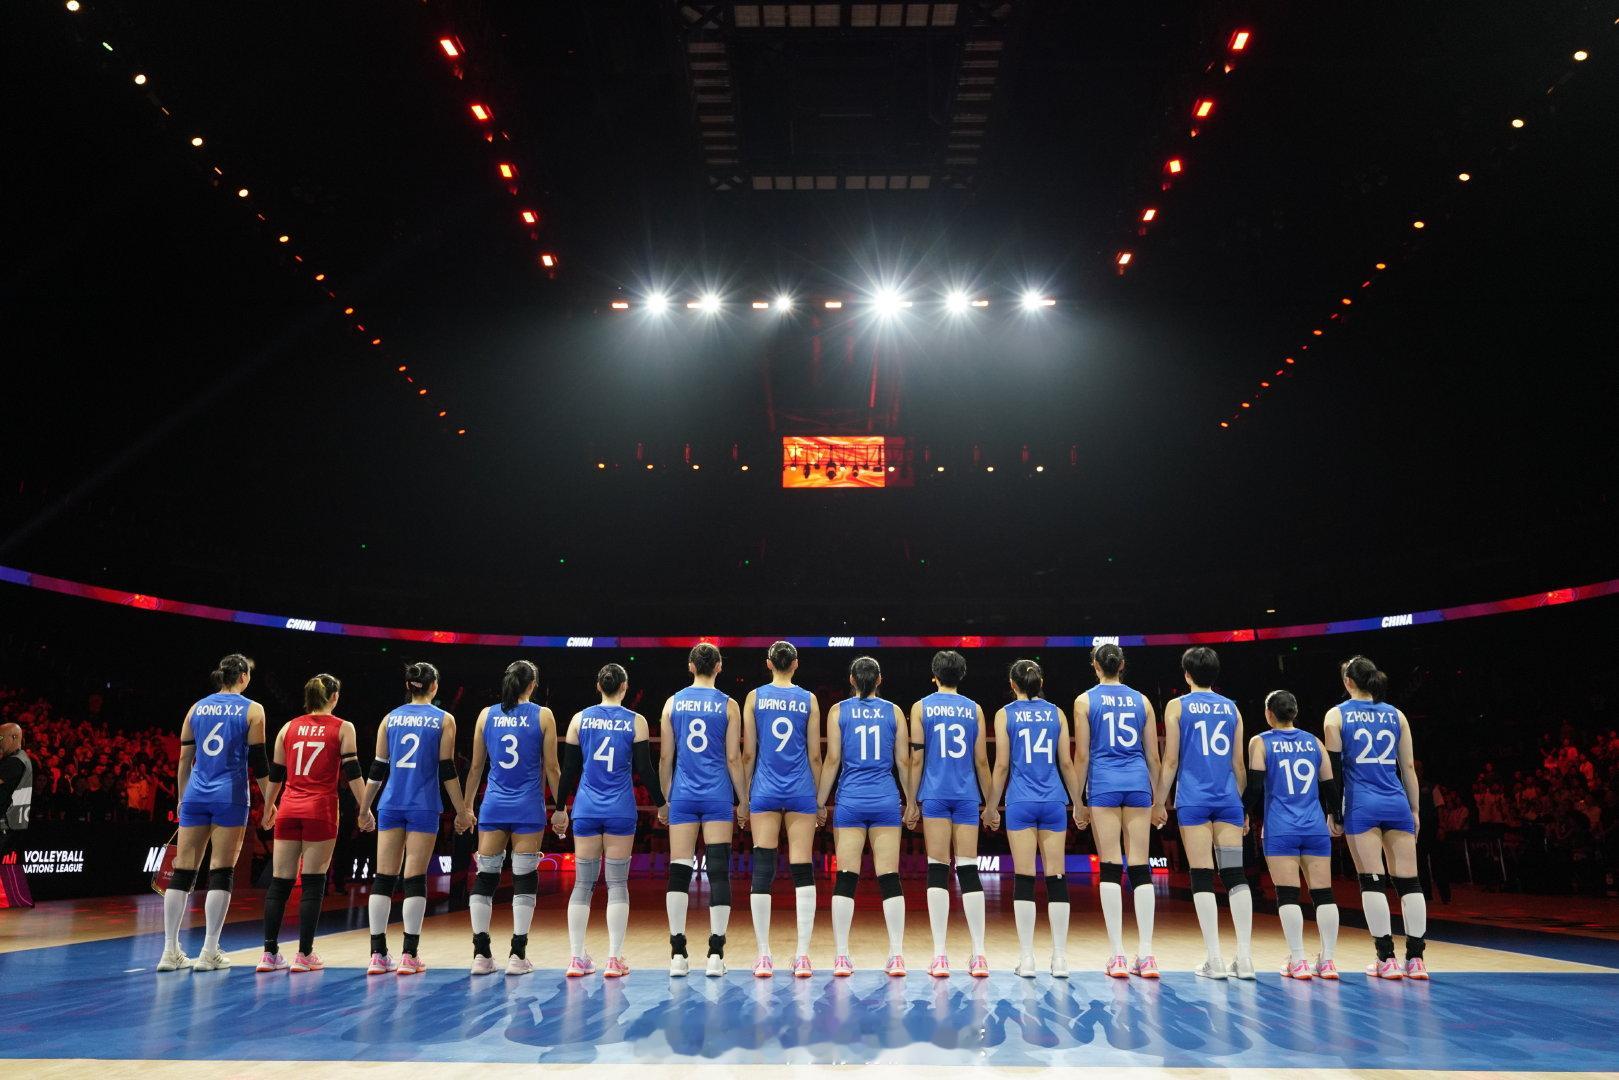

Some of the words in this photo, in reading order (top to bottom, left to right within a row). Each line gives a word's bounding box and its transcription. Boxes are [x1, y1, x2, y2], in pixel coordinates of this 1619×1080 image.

[286, 618, 317, 631] CHINA
[1382, 614, 1412, 627] CHINA
[567, 636, 594, 648] CHINA
[828, 636, 855, 648] CHINA
[675, 700, 702, 712] CHEN
[758, 698, 787, 711] WANG
[1100, 694, 1115, 706] JIN
[1117, 695, 1137, 707] J.B.
[196, 704, 222, 717] GONG
[223, 704, 244, 717] X.Y.
[851, 708, 861, 719] LI
[862, 708, 885, 719] C.X.
[926, 706, 955, 717] DONG
[956, 706, 975, 720] Y.H.
[1188, 702, 1211, 714] GUO
[388, 715, 423, 728] ZHUANG
[423, 716, 440, 730] Y.S.
[493, 716, 517, 728] TANG
[519, 716, 530, 728] X.
[1015, 710, 1033, 722] XIE
[1035, 711, 1053, 722] S.Y.
[1346, 711, 1375, 724] ZHOU
[1376, 711, 1397, 725] Y.T.
[297, 725, 309, 737] NI
[310, 725, 326, 737] F.F.
[581, 717, 613, 731] ZHANG
[613, 719, 633, 732] Z.X.
[1102, 712, 1138, 748] 15
[202, 722, 224, 757] 6
[686, 718, 709, 753] 8
[771, 716, 794, 752] 9
[933, 723, 967, 759] 13
[1194, 720, 1231, 756] 16
[854, 725, 881, 761] 11
[1018, 728, 1053, 764] 14
[1272, 740, 1293, 753] ZHU
[1294, 741, 1316, 753] X.C.
[1353, 728, 1397, 765] 22
[395, 733, 420, 769] 2
[498, 734, 519, 769] 3
[593, 736, 615, 772] 4
[292, 741, 325, 776] 17
[1278, 759, 1316, 795] 19
[24, 850, 84, 863] VOLLEYBALL
[56, 863, 84, 873] LEAGUE
